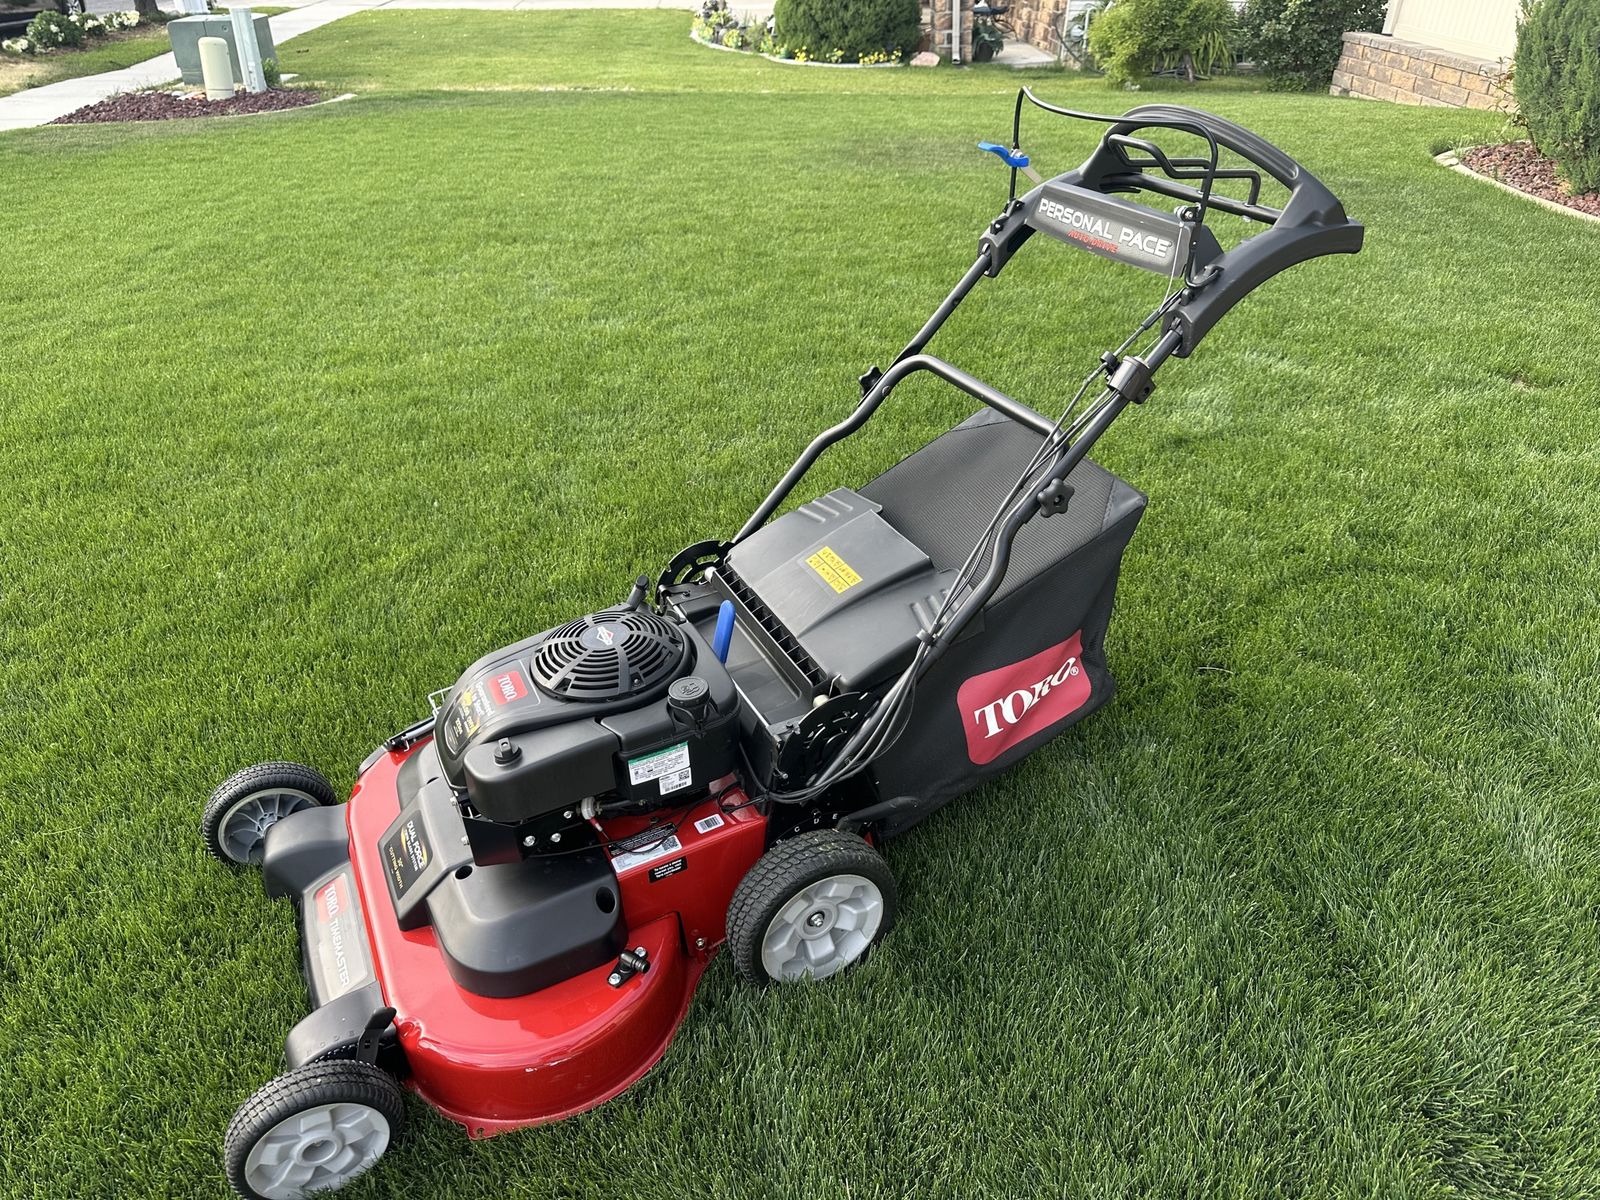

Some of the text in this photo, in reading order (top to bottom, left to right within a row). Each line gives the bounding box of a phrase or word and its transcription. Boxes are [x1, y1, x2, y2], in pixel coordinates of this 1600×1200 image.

[1038, 198, 1171, 258] PERSONAL PACE
[497, 674, 518, 701] TORO
[974, 657, 1077, 738] TORO
[407, 820, 425, 868] DUAL FORCE
[324, 883, 350, 988] TORO TIMEMASTER
